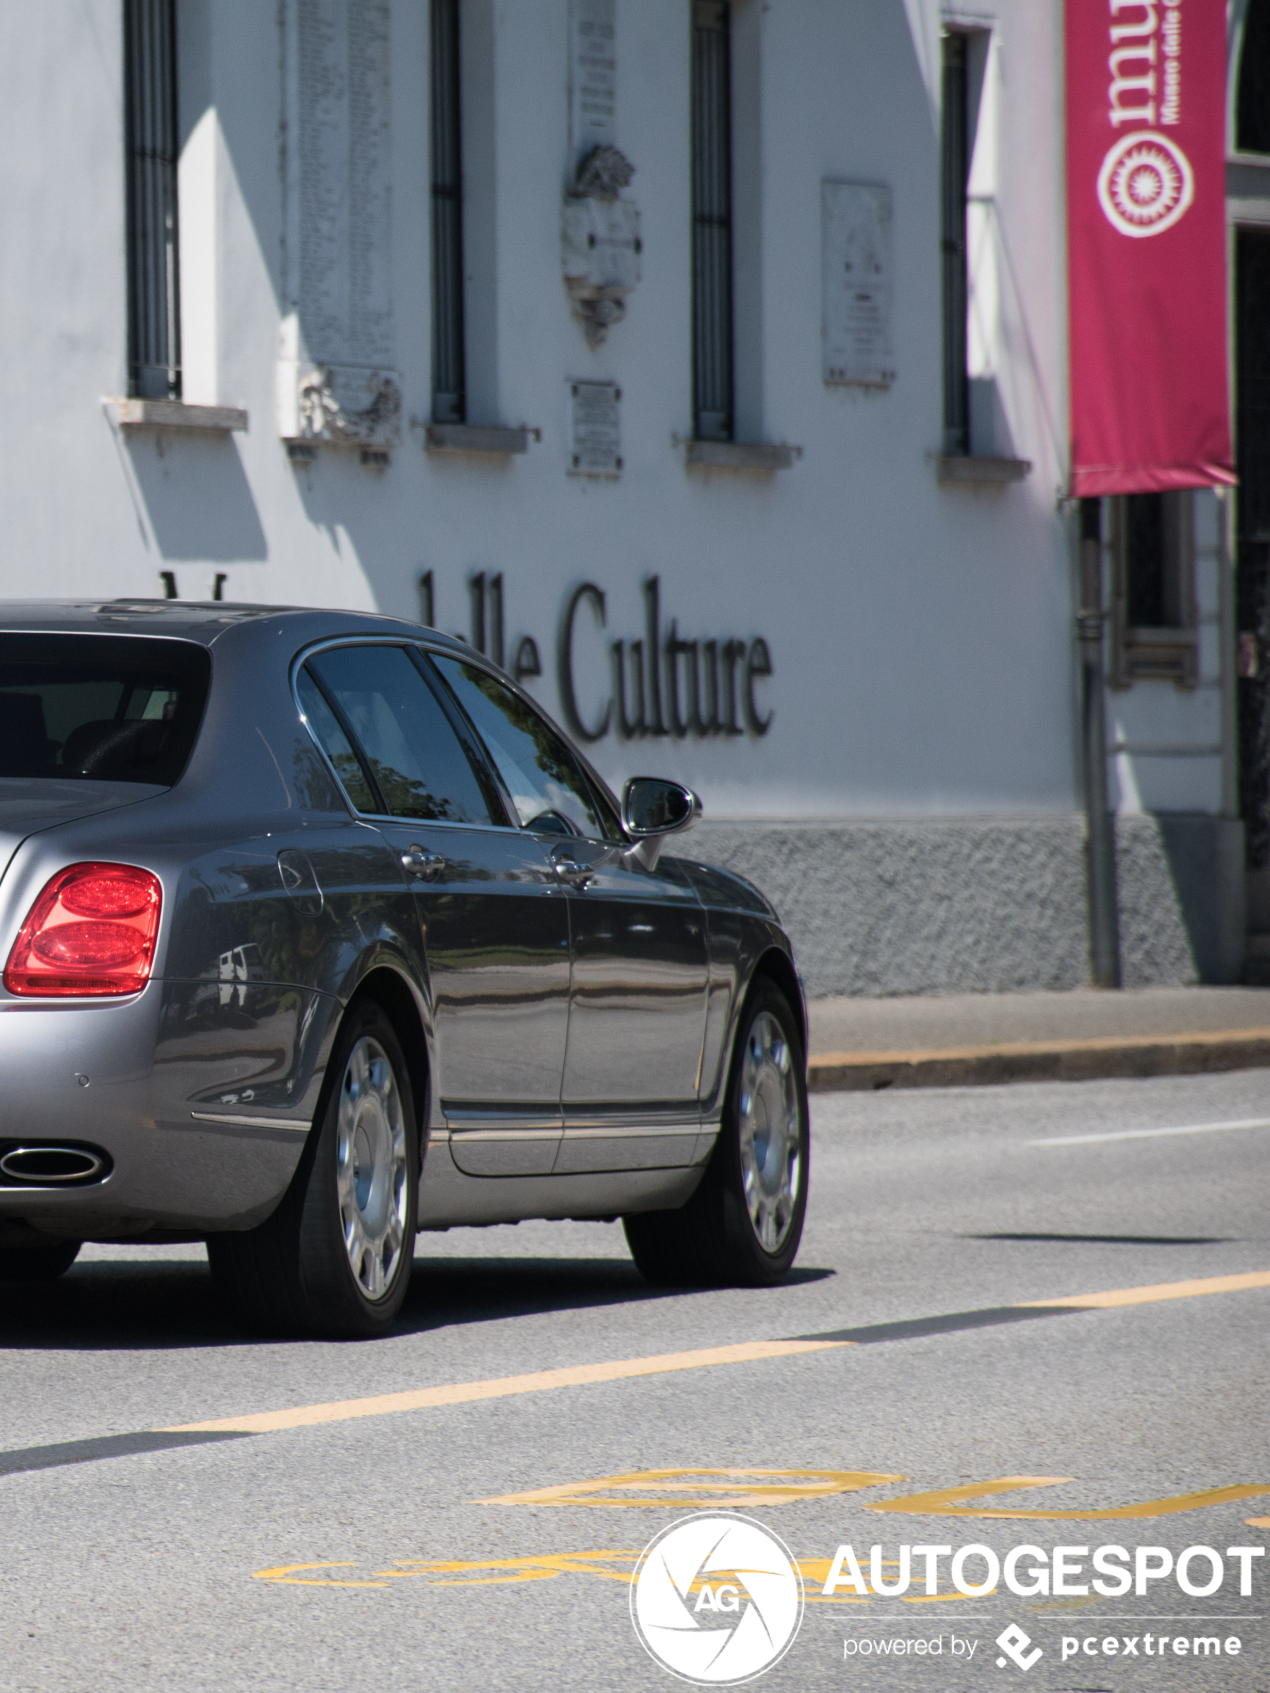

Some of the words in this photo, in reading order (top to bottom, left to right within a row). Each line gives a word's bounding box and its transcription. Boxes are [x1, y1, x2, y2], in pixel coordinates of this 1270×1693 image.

[1161, 8, 1182, 57] delle
[1160, 58, 1181, 126] Museo
[556, 573, 774, 744] Culture
